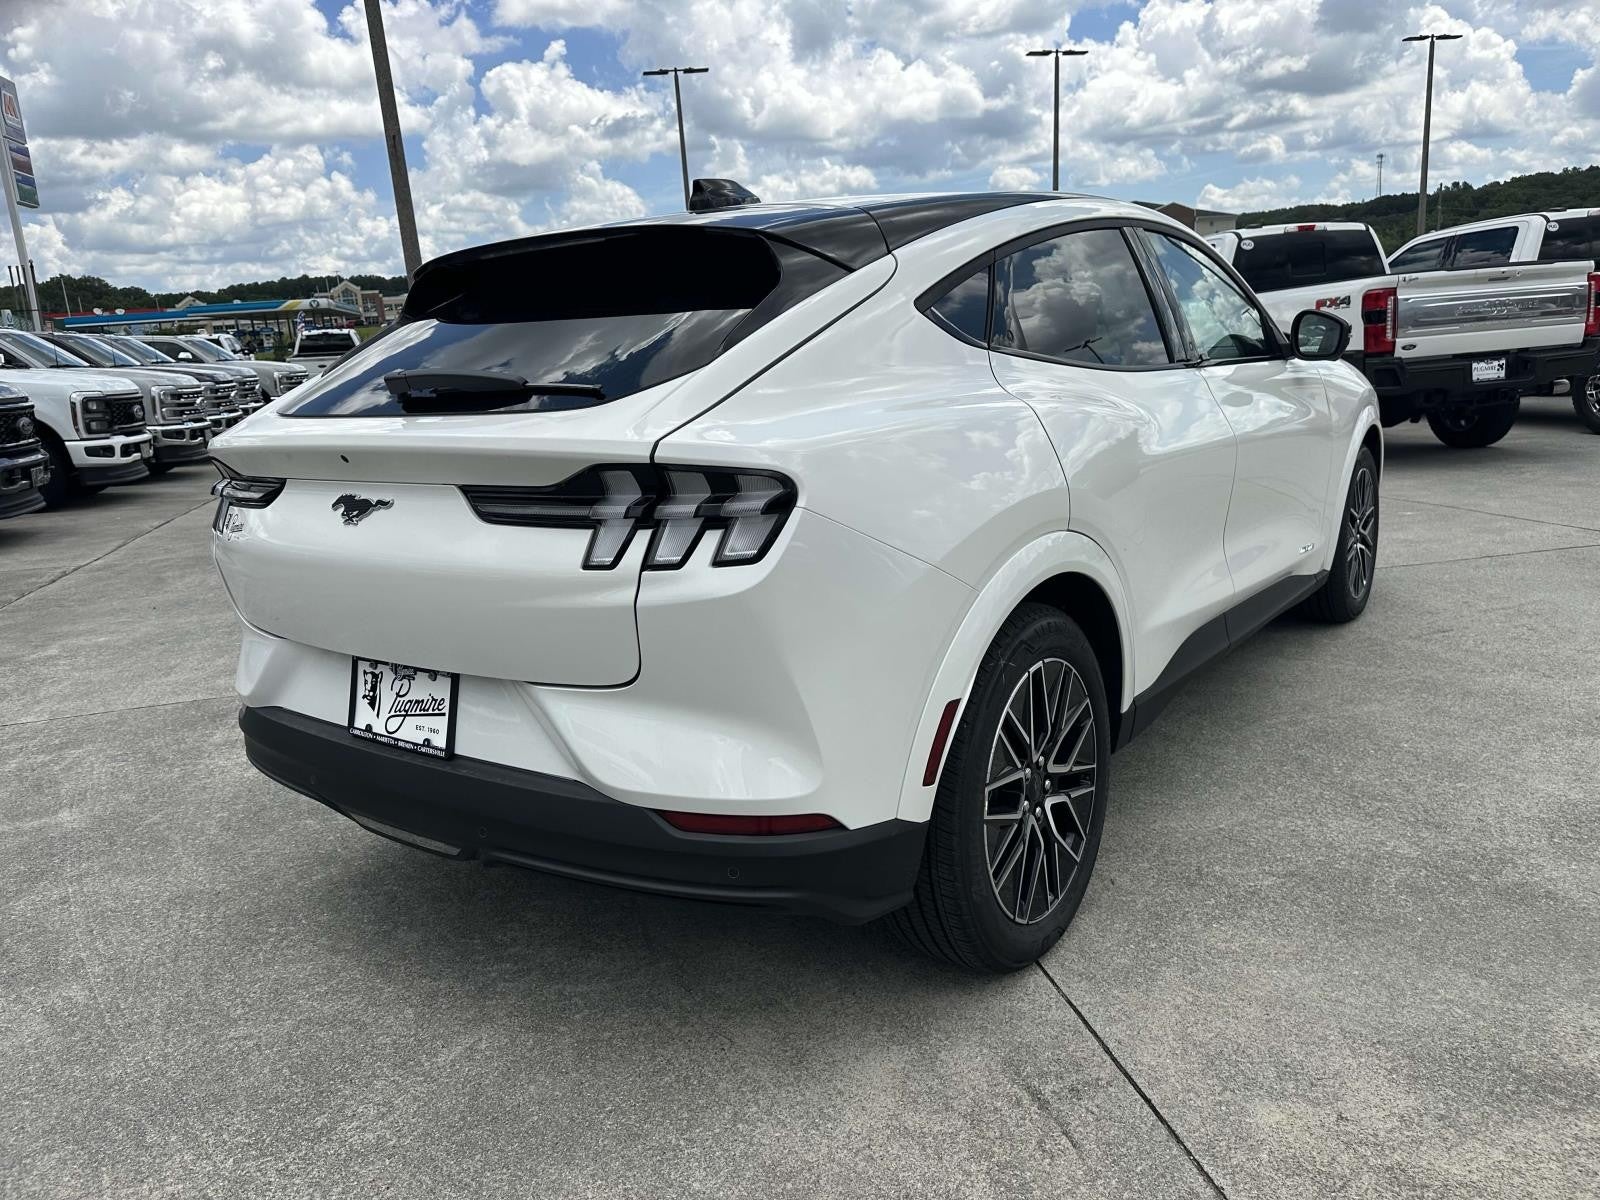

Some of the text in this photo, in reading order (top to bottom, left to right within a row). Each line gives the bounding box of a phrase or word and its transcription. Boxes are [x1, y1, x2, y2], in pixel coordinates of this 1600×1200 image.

[1315, 295, 1351, 311] FX4
[385, 677, 446, 735] Pugmire
[427, 726, 440, 735] 1960
